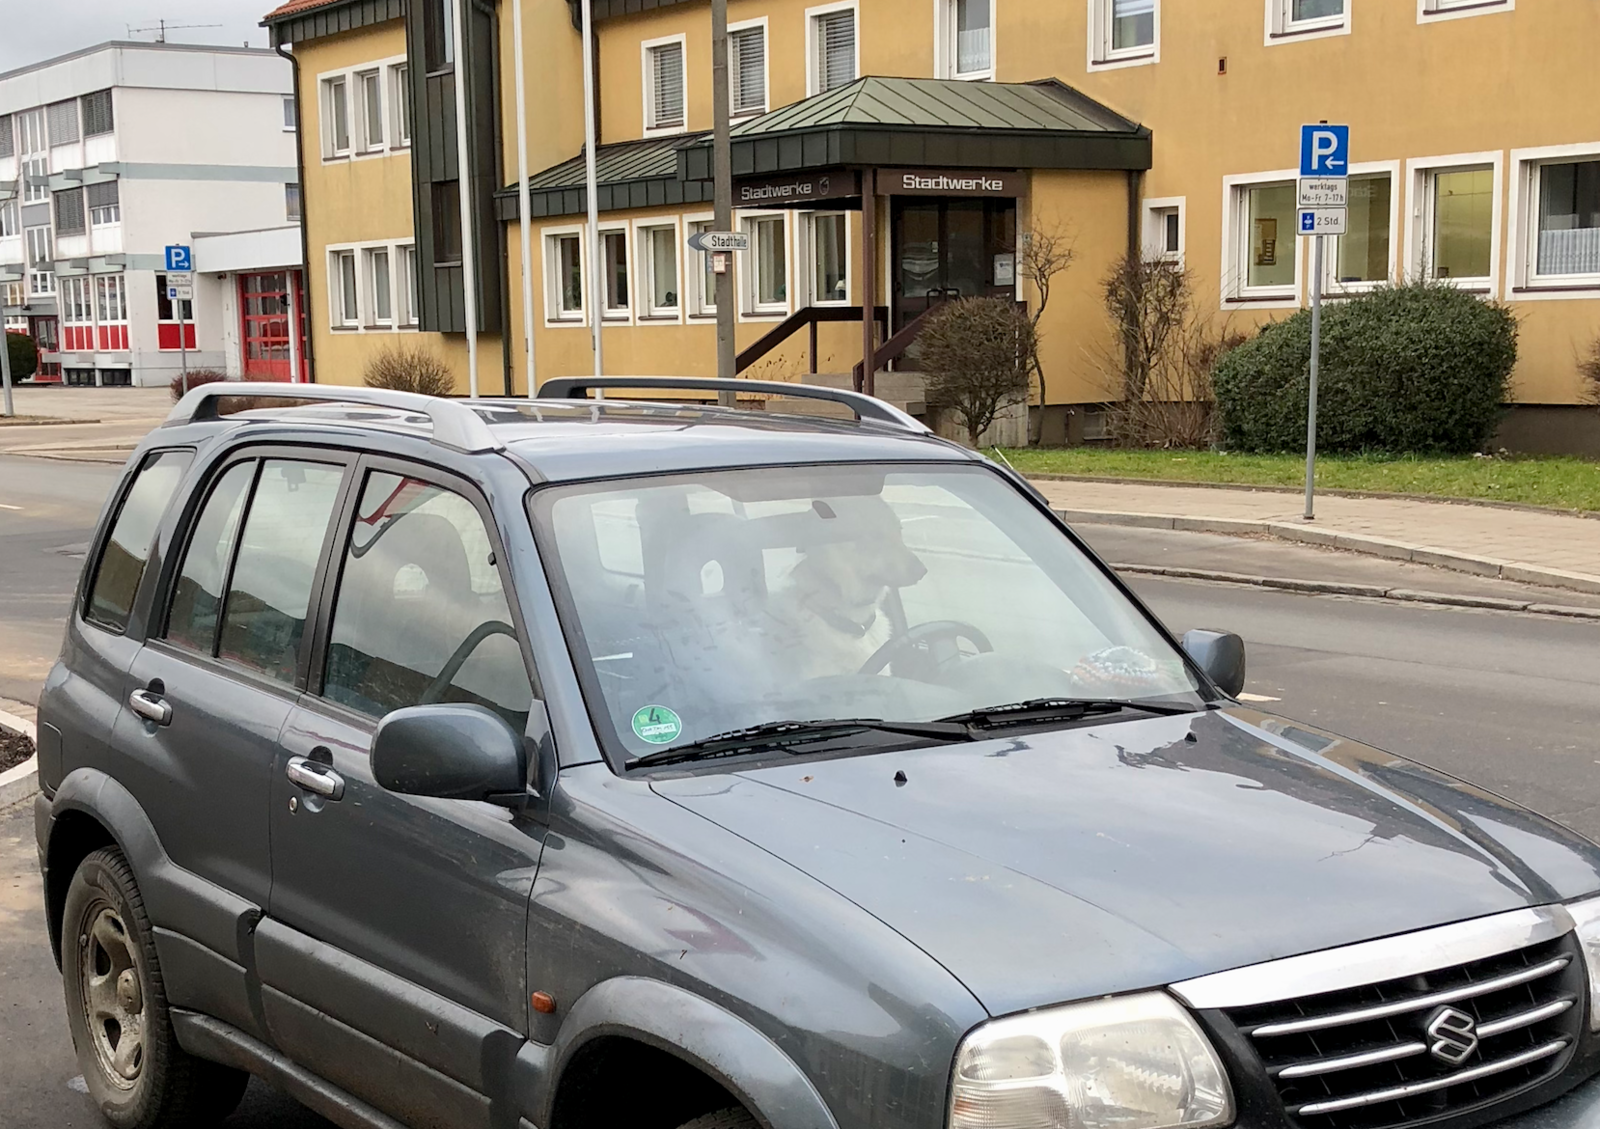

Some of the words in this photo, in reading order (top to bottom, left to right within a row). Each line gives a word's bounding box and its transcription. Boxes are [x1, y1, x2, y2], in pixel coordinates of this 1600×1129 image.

[1311, 131, 1338, 170] P
[741, 181, 812, 200] Stadtwerke
[903, 174, 1003, 191] Stadtwerke
[1309, 182, 1338, 192] werktags
[1316, 217, 1322, 226] 2
[711, 235, 747, 248] Stadthalle
[171, 248, 186, 268] P
[649, 708, 662, 724] 4
